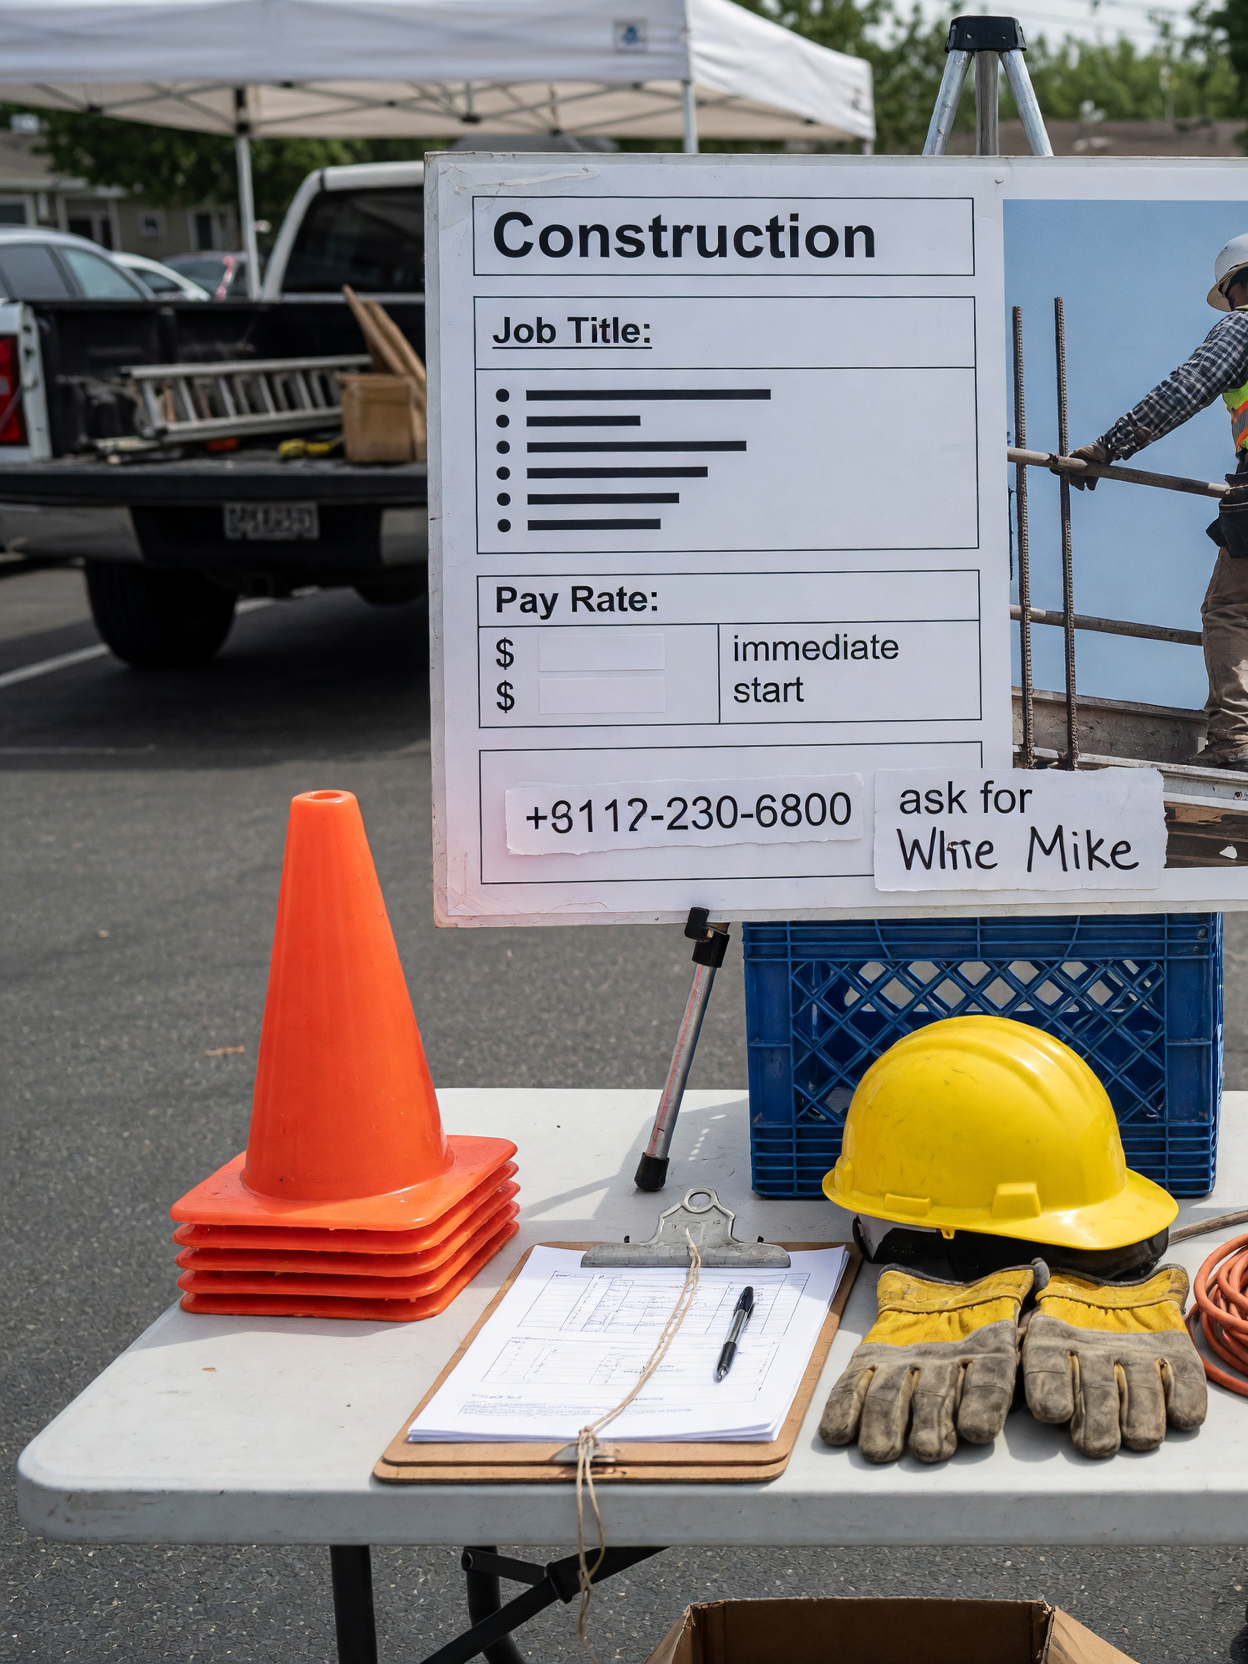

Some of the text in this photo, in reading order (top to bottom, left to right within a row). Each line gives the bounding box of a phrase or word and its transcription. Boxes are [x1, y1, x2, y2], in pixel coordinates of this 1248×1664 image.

[493, 211, 876, 260] Construction
[492, 316, 651, 344] Job Title:
[496, 585, 658, 621] Pay Rate:
[495, 636, 515, 671] $
[734, 633, 899, 662] immediate
[496, 679, 515, 714] $
[733, 676, 805, 704] start
[899, 780, 1033, 815] ask for
[1026, 824, 1140, 873] Mike
